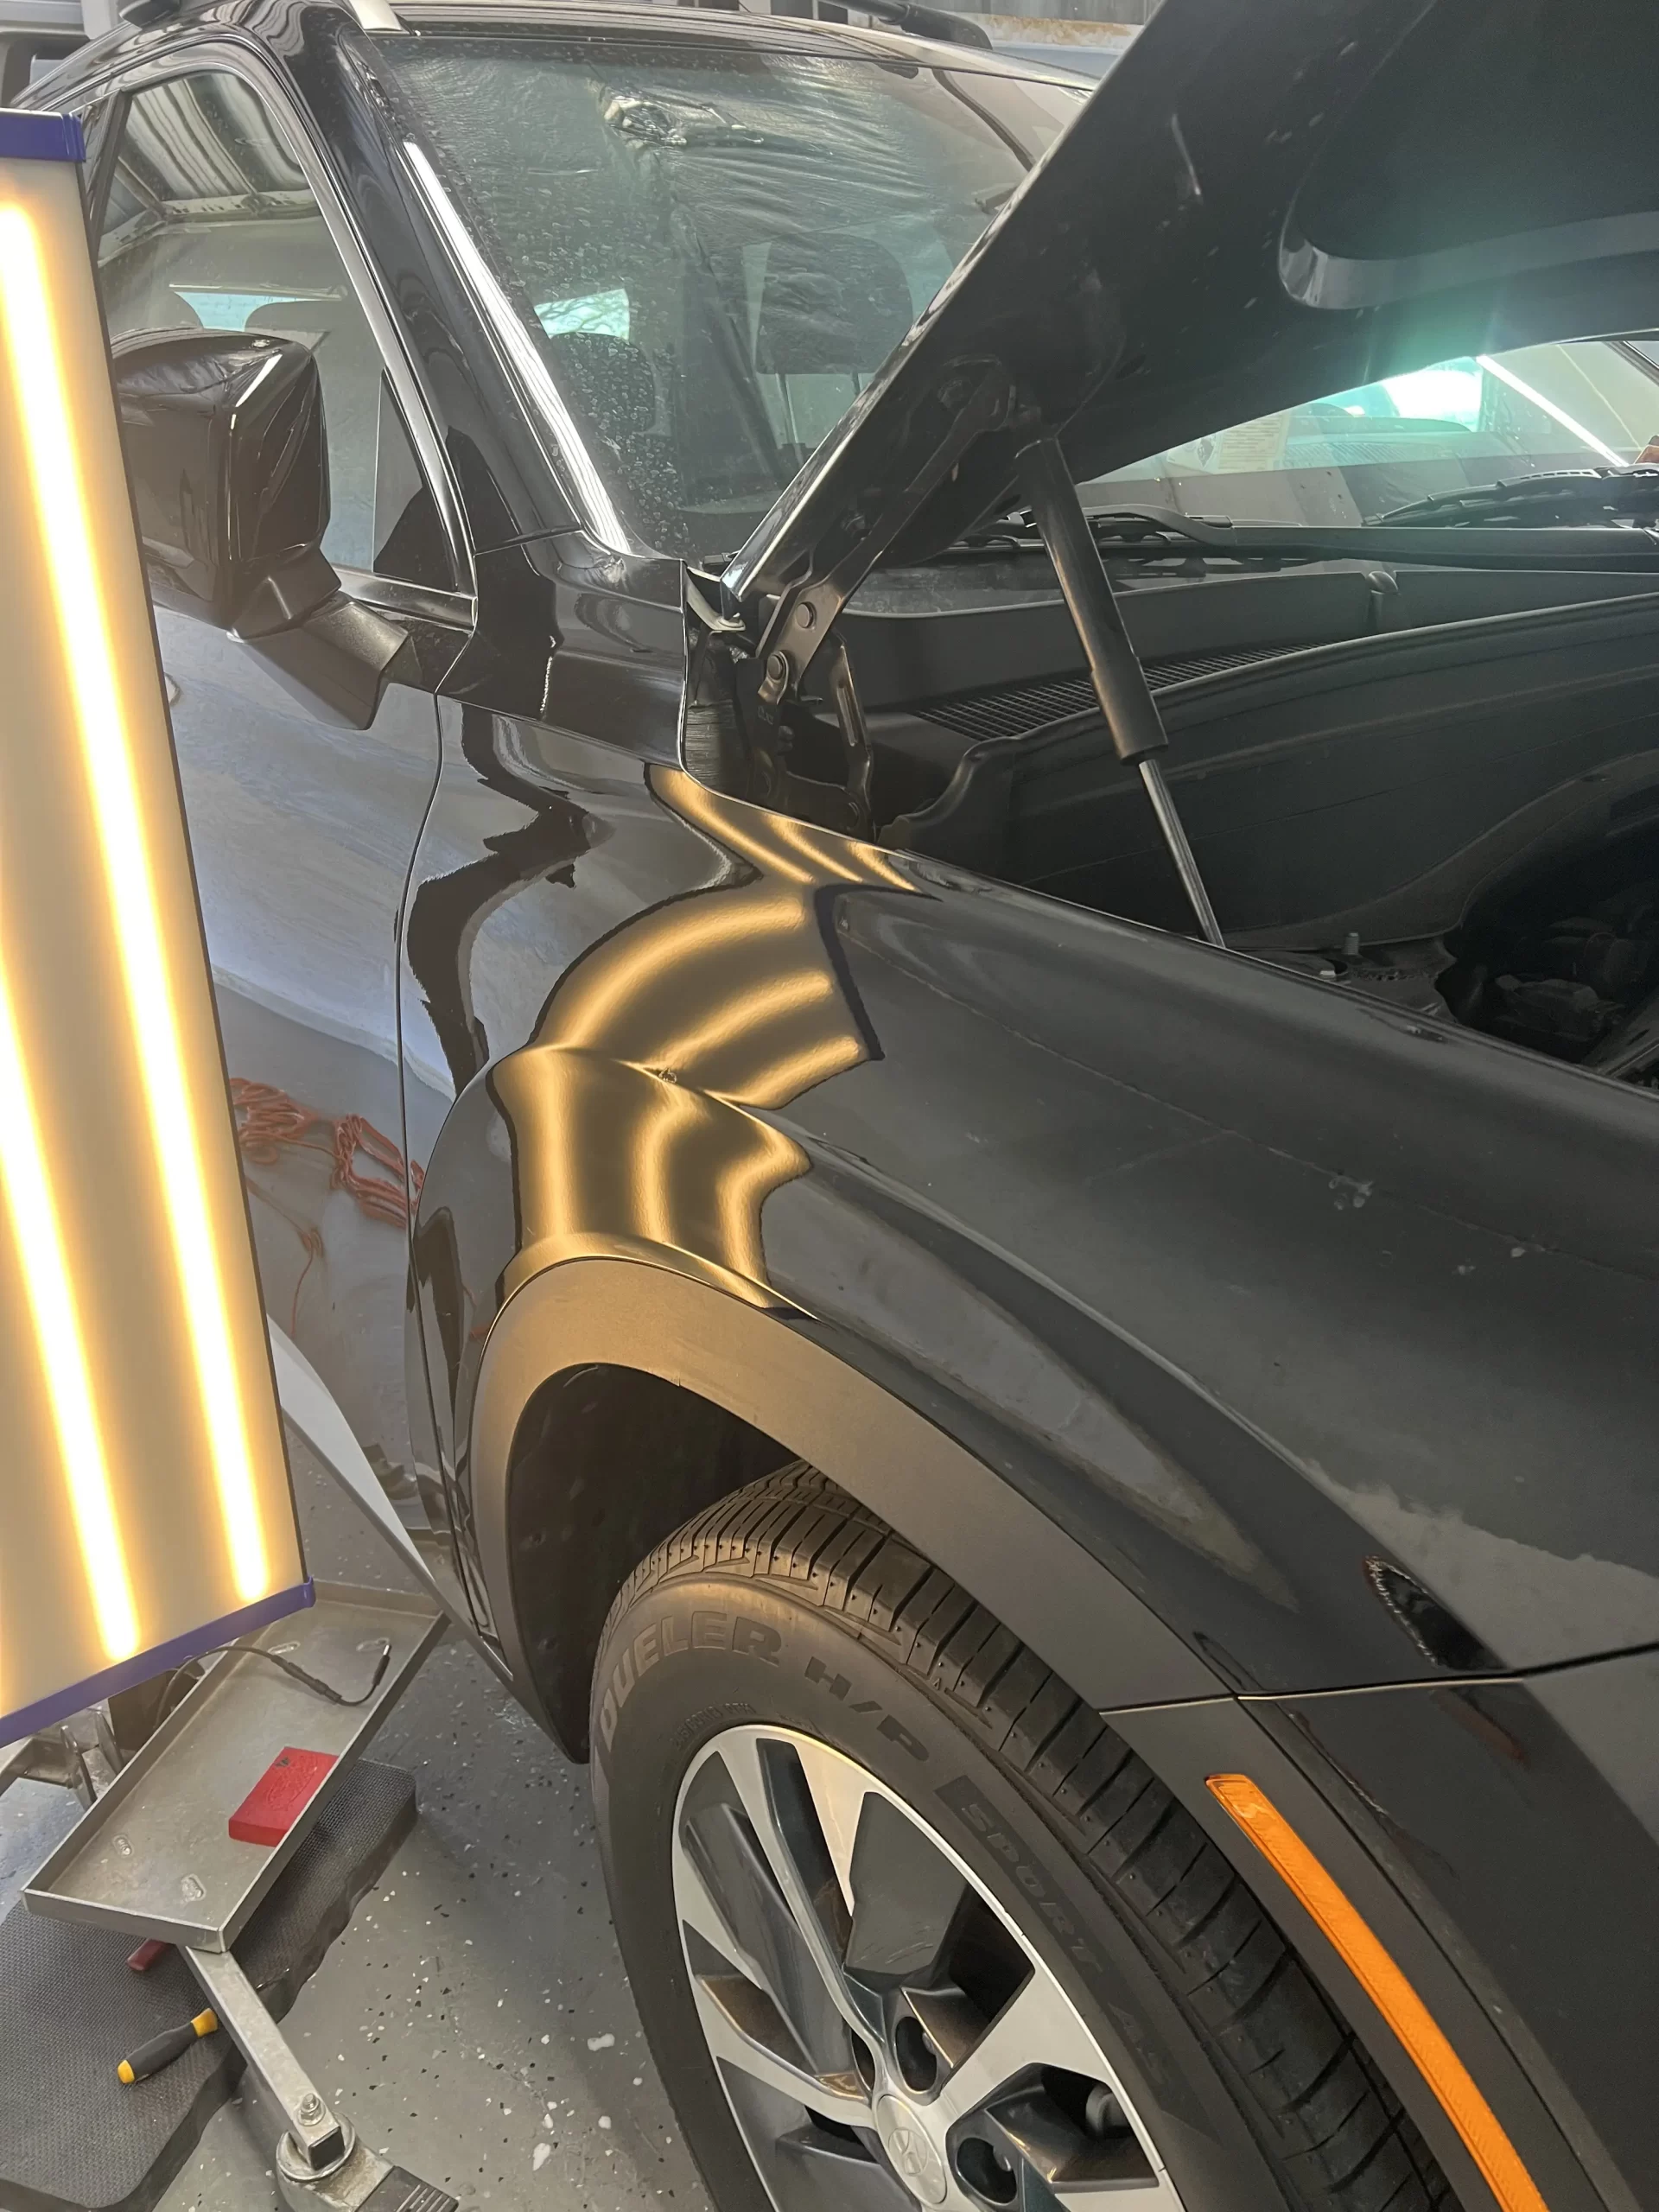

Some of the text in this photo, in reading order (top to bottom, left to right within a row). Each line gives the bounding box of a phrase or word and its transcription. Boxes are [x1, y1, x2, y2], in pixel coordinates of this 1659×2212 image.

[600, 1611, 782, 1753] DUELER
[804, 1656, 930, 1762] H/P
[961, 1803, 1104, 1974] SPORT
